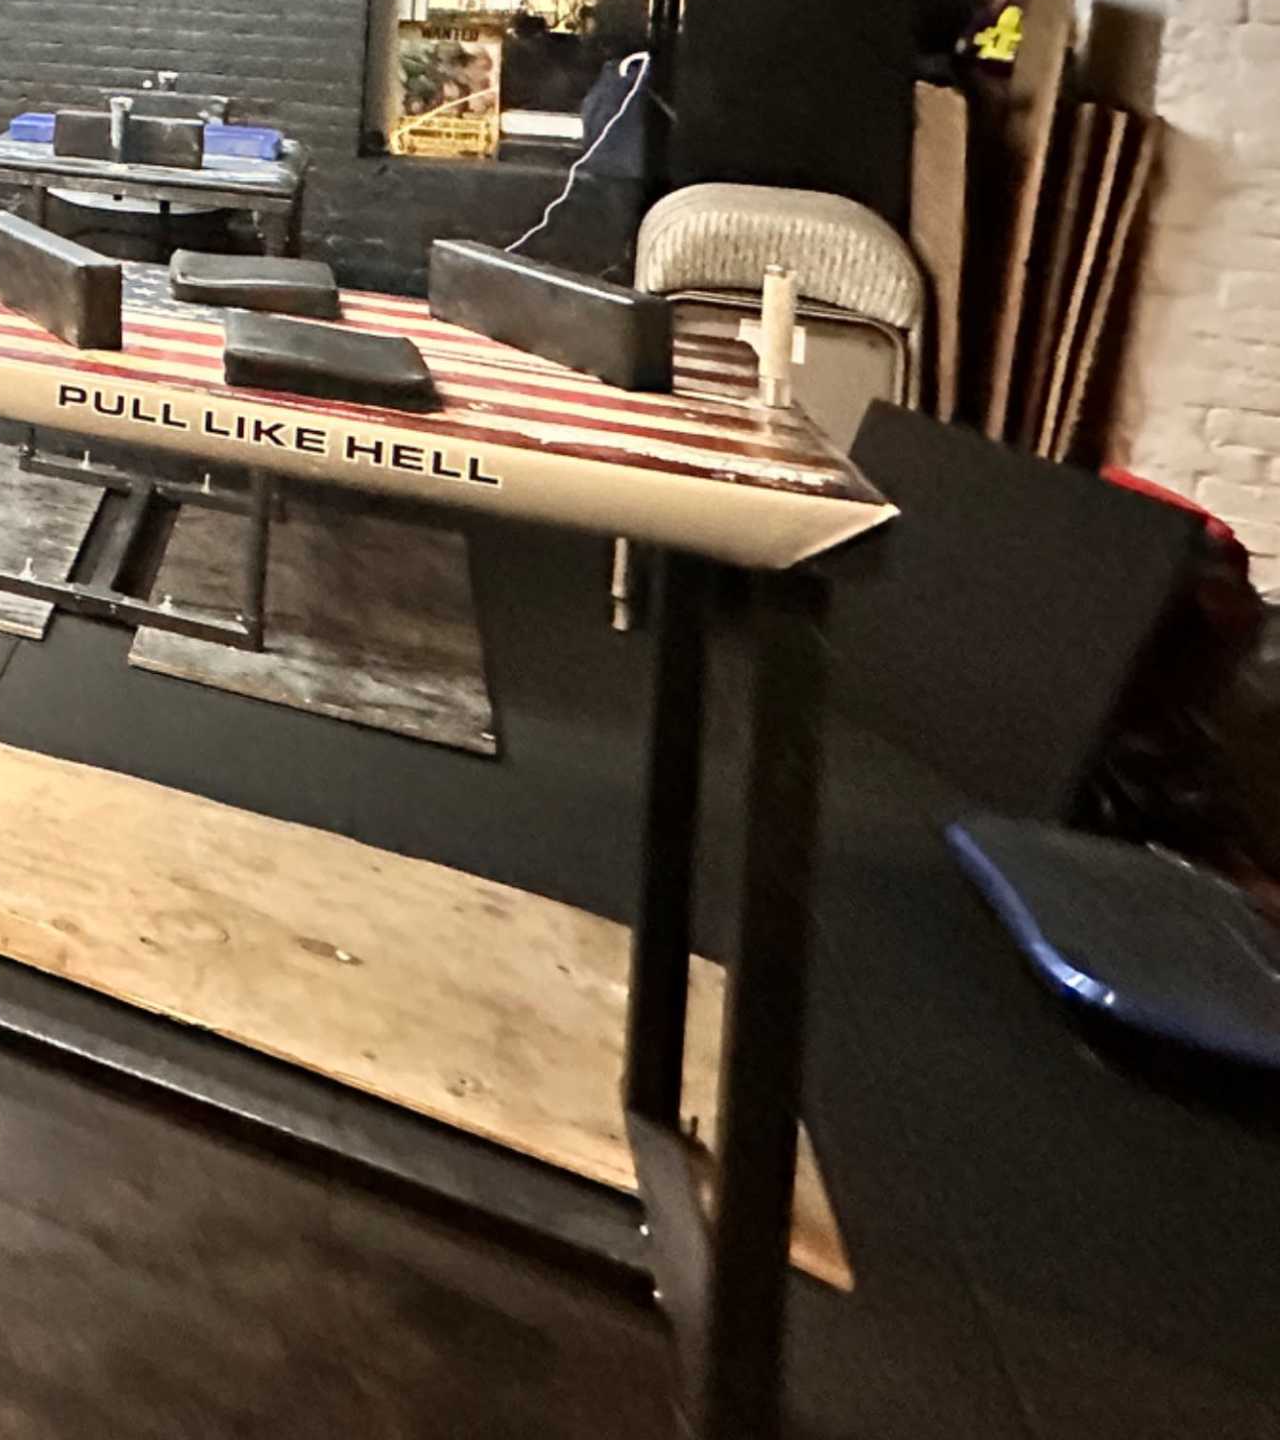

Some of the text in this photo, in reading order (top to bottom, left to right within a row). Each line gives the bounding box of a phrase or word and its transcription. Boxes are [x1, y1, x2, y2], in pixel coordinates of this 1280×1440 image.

[58, 385, 500, 485] PULL LIKE HELL
